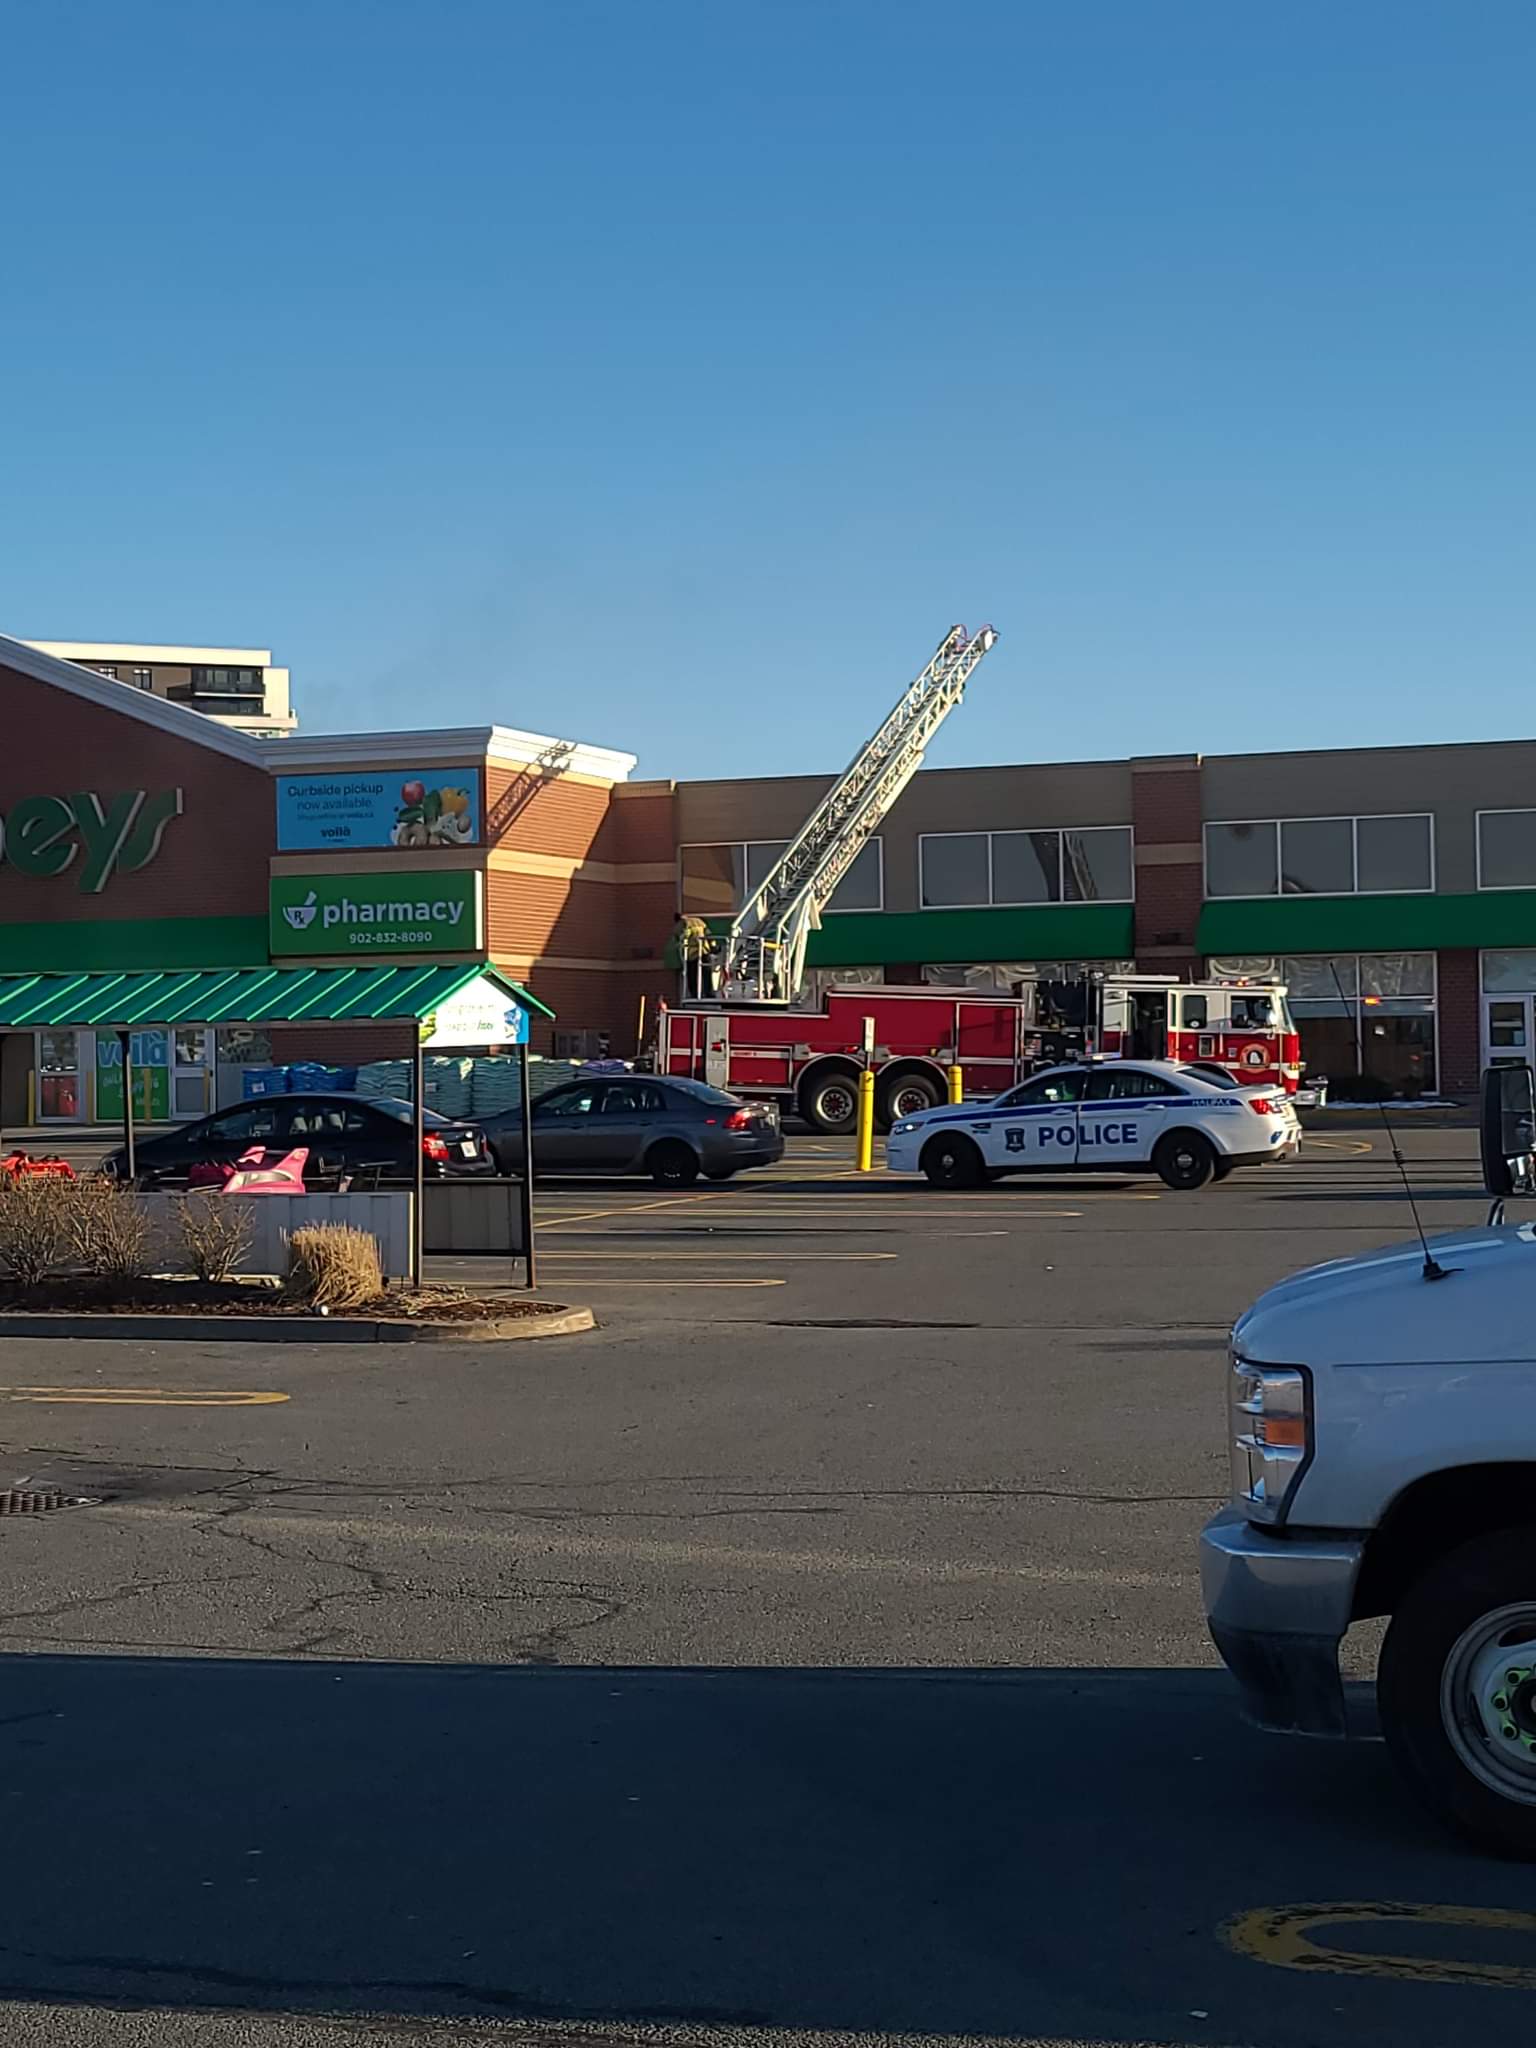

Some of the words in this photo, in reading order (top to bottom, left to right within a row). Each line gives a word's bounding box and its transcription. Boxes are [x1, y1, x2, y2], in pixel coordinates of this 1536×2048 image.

[288, 784, 341, 797] Curbside
[343, 782, 384, 796] pickup
[297, 800, 321, 810] now
[0, 787, 183, 893] eys
[323, 898, 465, 929] pharmacy
[350, 931, 433, 944] 902-832-8090
[1192, 1098, 1231, 1107] HALIFAX
[1038, 1123, 1139, 1147] POLICE
